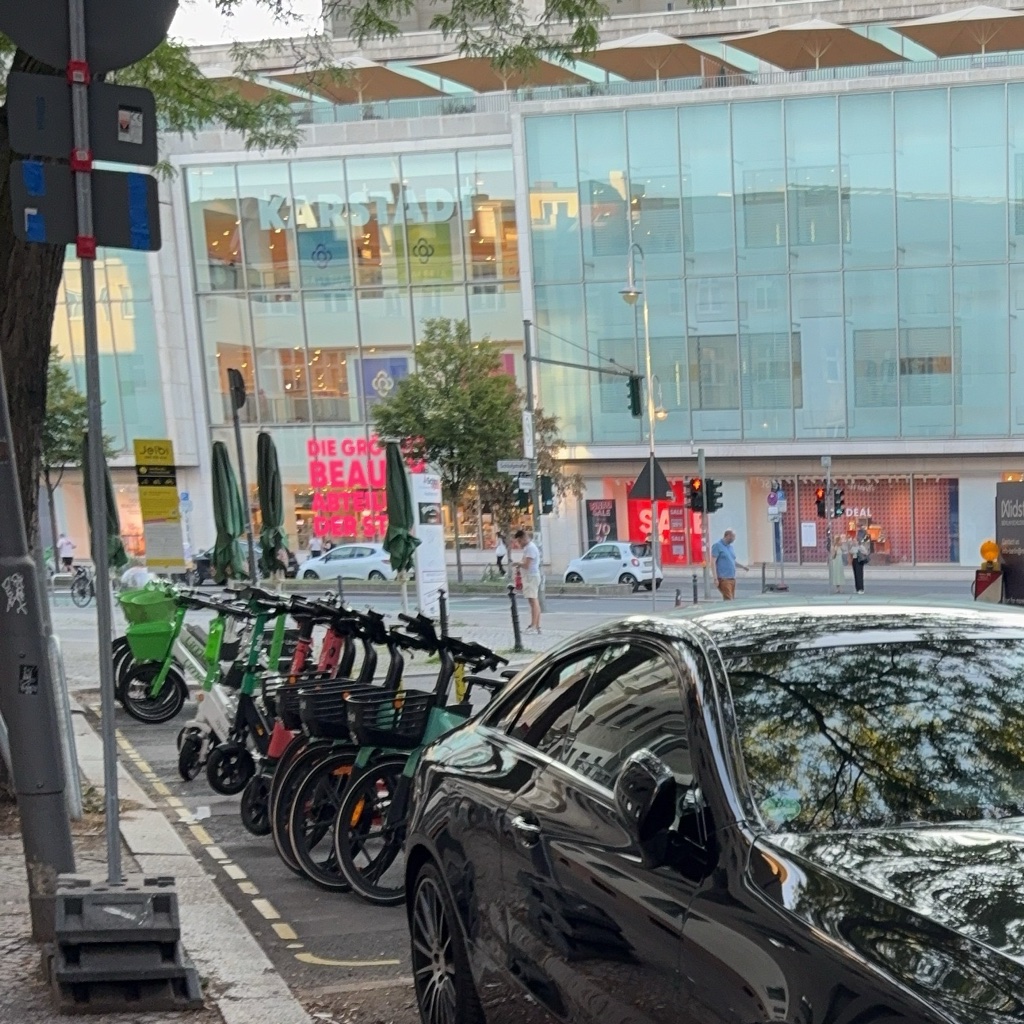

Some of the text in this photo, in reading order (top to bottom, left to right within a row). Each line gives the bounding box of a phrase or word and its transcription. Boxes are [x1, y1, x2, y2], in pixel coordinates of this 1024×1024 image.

[259, 186, 474, 230] KARSTADT
[308, 438, 337, 457] DIE
[845, 507, 872, 517] DEAL
[314, 515, 357, 538] DER
[594, 522, 611, 536] 70
